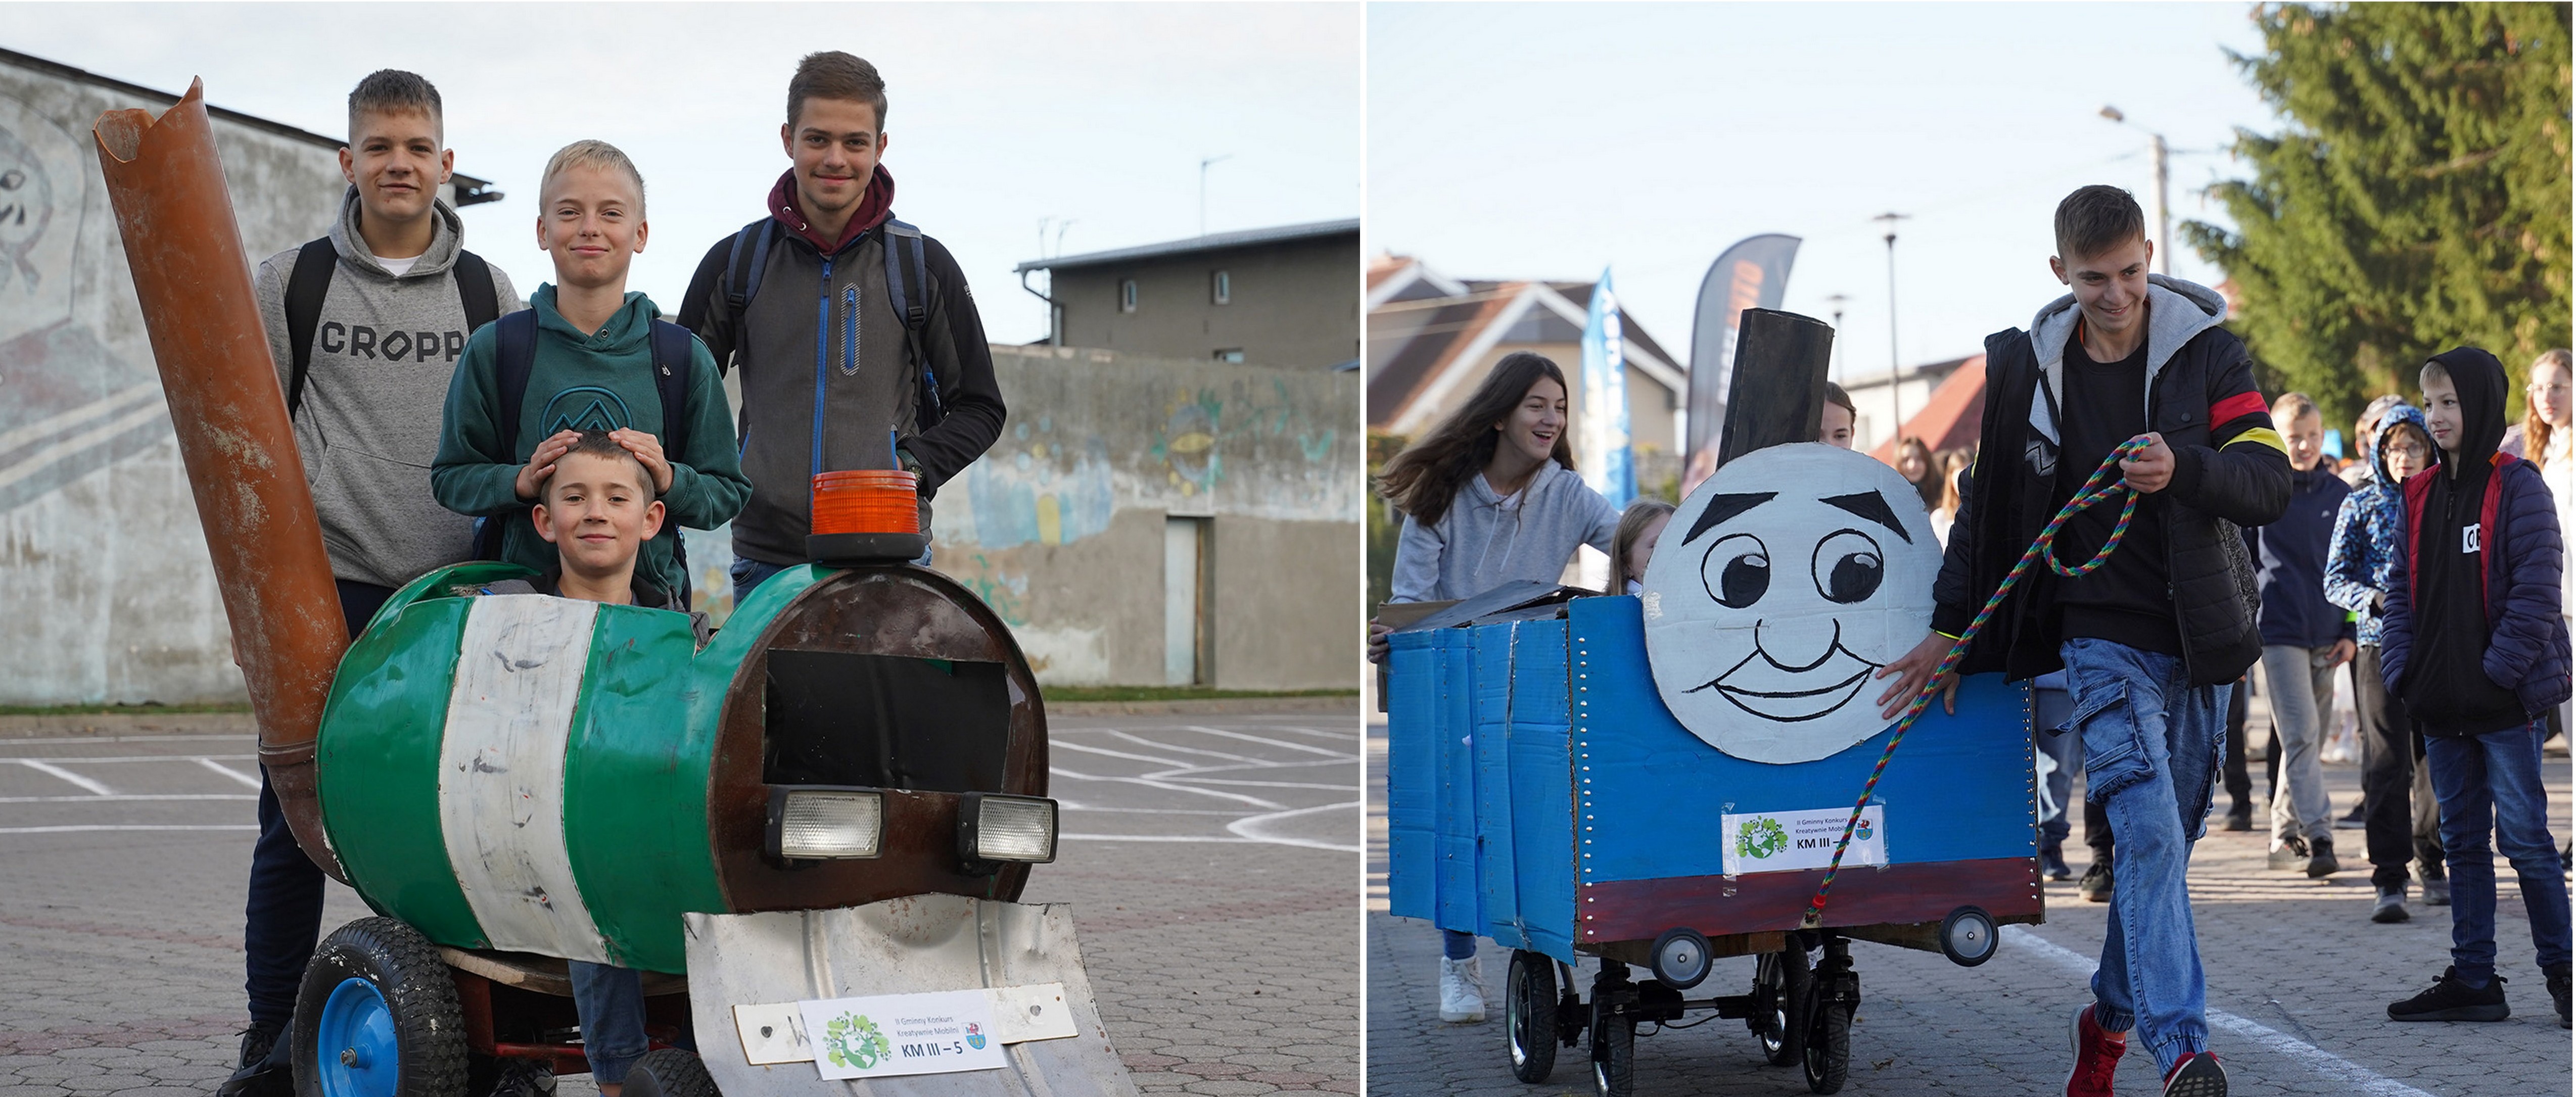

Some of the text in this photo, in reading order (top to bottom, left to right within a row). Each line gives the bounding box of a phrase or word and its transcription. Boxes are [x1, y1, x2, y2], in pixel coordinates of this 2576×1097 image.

[321, 321, 464, 362] CROPP
[1797, 838, 1816, 849] KM
[1819, 837, 1830, 847] III
[901, 1017, 926, 1026] Gminny
[926, 1015, 954, 1024] Konkurs
[897, 1026, 960, 1037] Kreatywnie Mobilni
[901, 1044, 925, 1058] KM
[926, 1042, 941, 1056] III
[954, 1041, 963, 1055] 5
